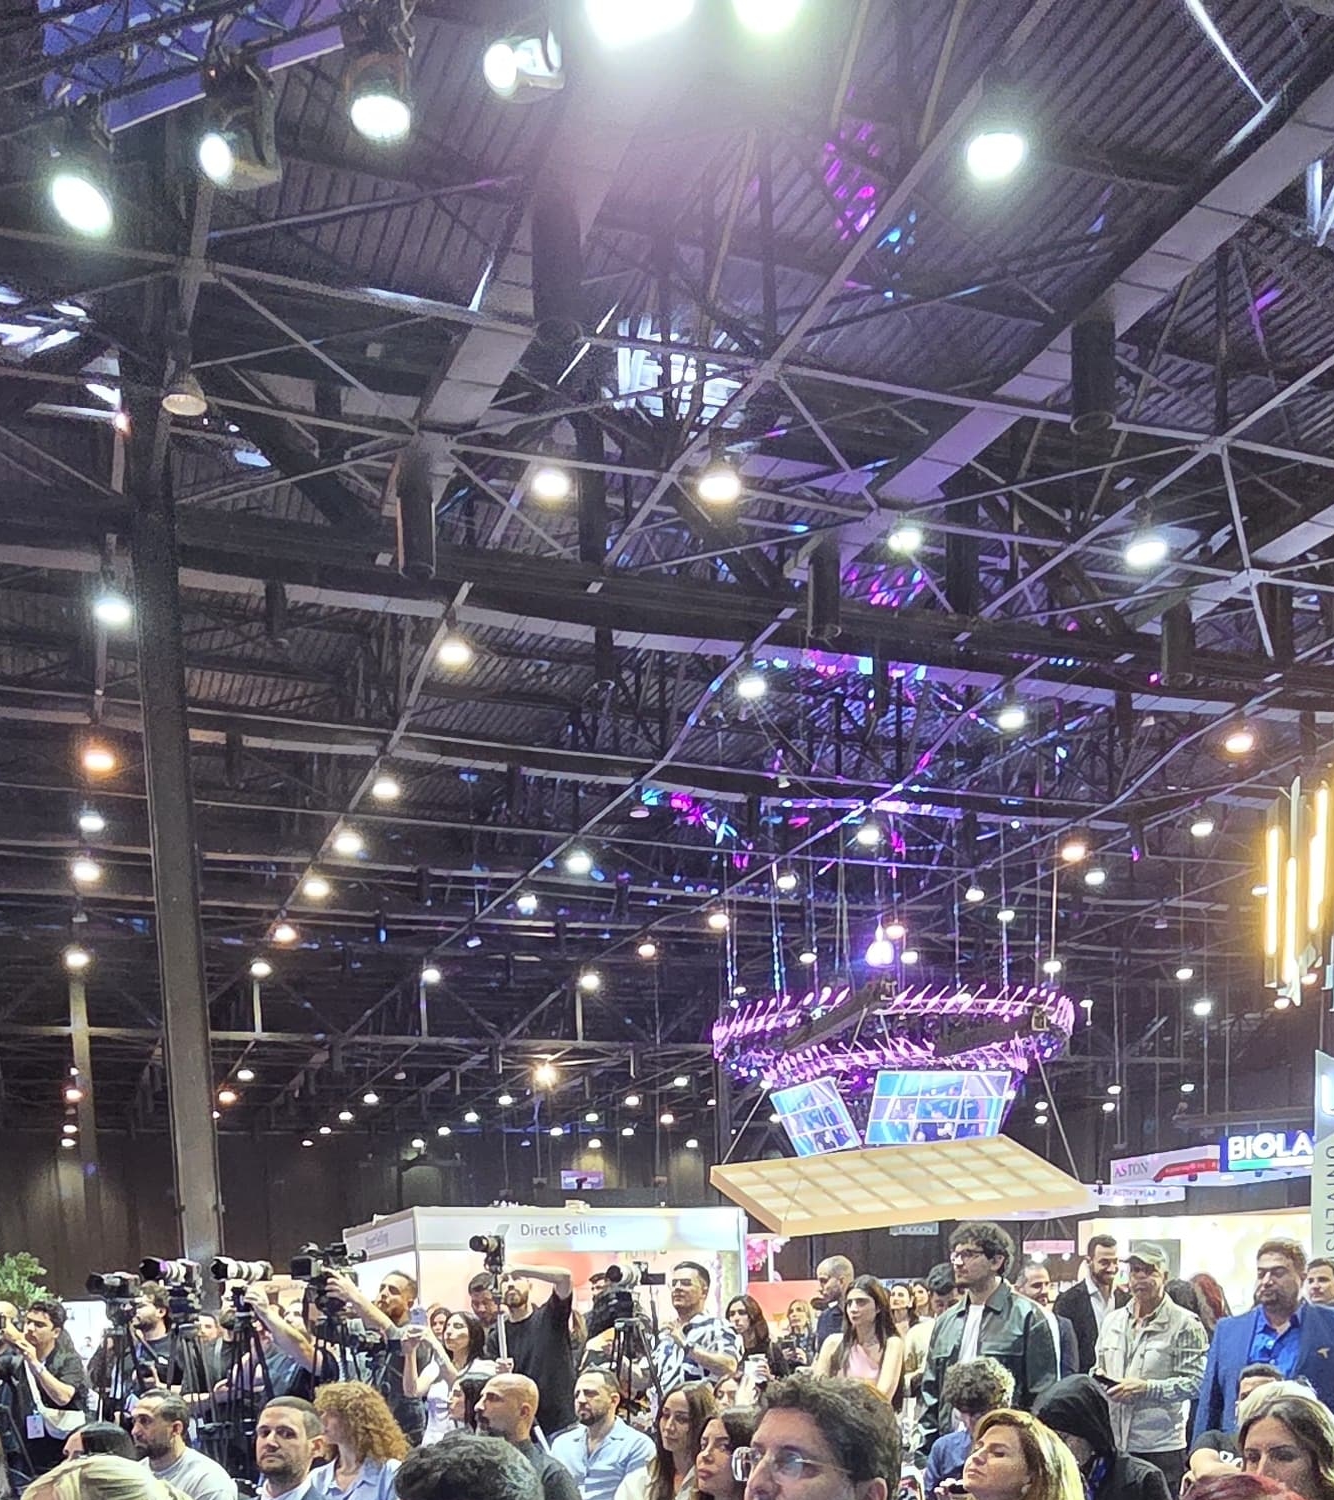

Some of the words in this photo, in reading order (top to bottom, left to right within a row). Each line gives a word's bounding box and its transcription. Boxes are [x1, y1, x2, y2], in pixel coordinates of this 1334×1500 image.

[1114, 1161, 1149, 1179] ASTON
[520, 1223, 560, 1236] Direct
[564, 1222, 607, 1238] Selling
